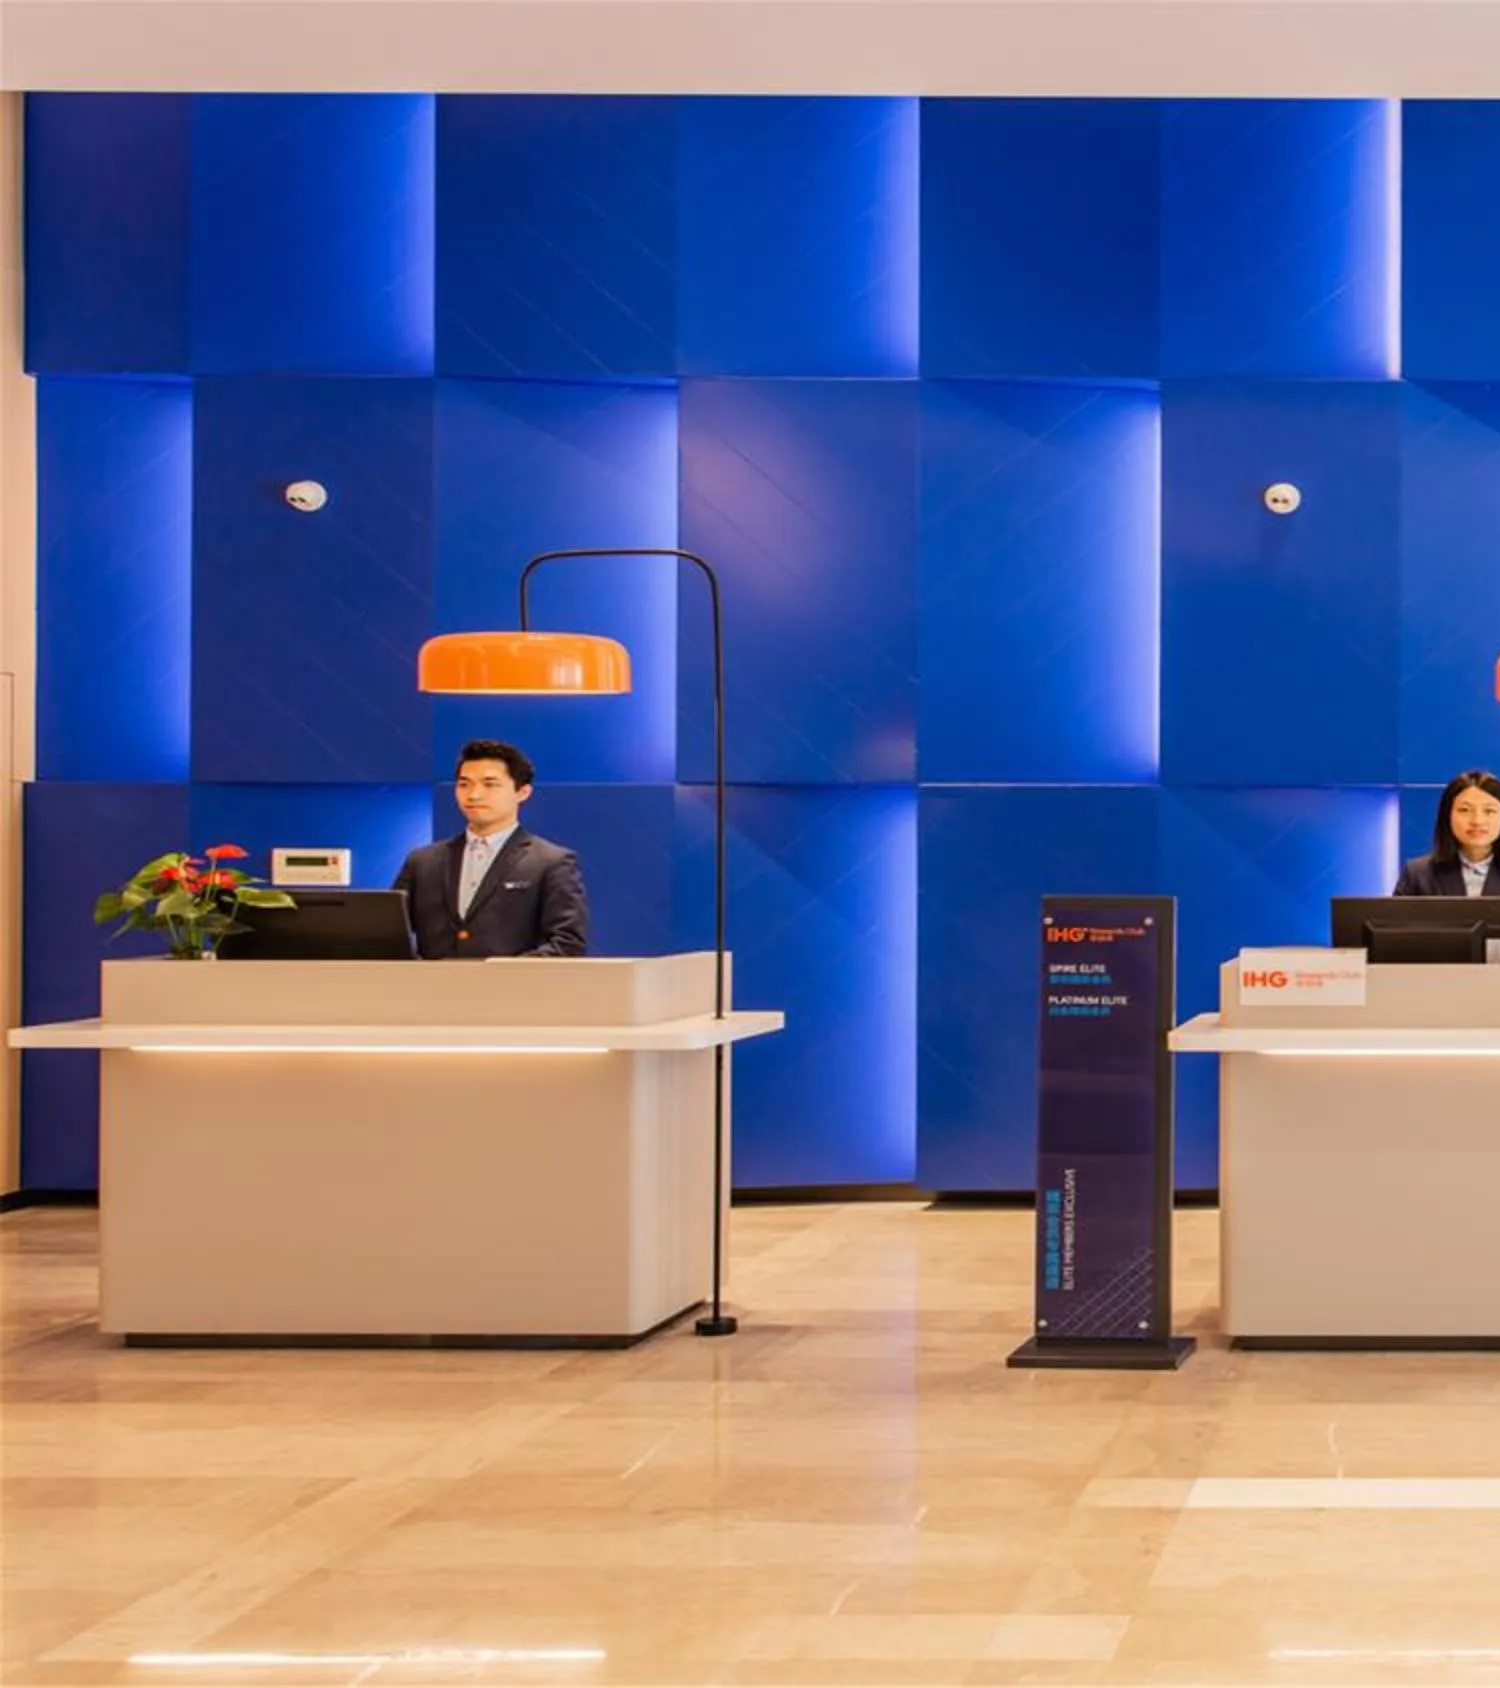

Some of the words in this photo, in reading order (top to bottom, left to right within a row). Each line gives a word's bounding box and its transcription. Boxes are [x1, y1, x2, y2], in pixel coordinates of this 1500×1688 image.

[1047, 928, 1085, 942] IHG
[1080, 964, 1106, 973] ELITE
[1243, 971, 1288, 988] IHG
[1048, 996, 1098, 1005] PLATINUM
[1101, 996, 1128, 1005] ELITE
